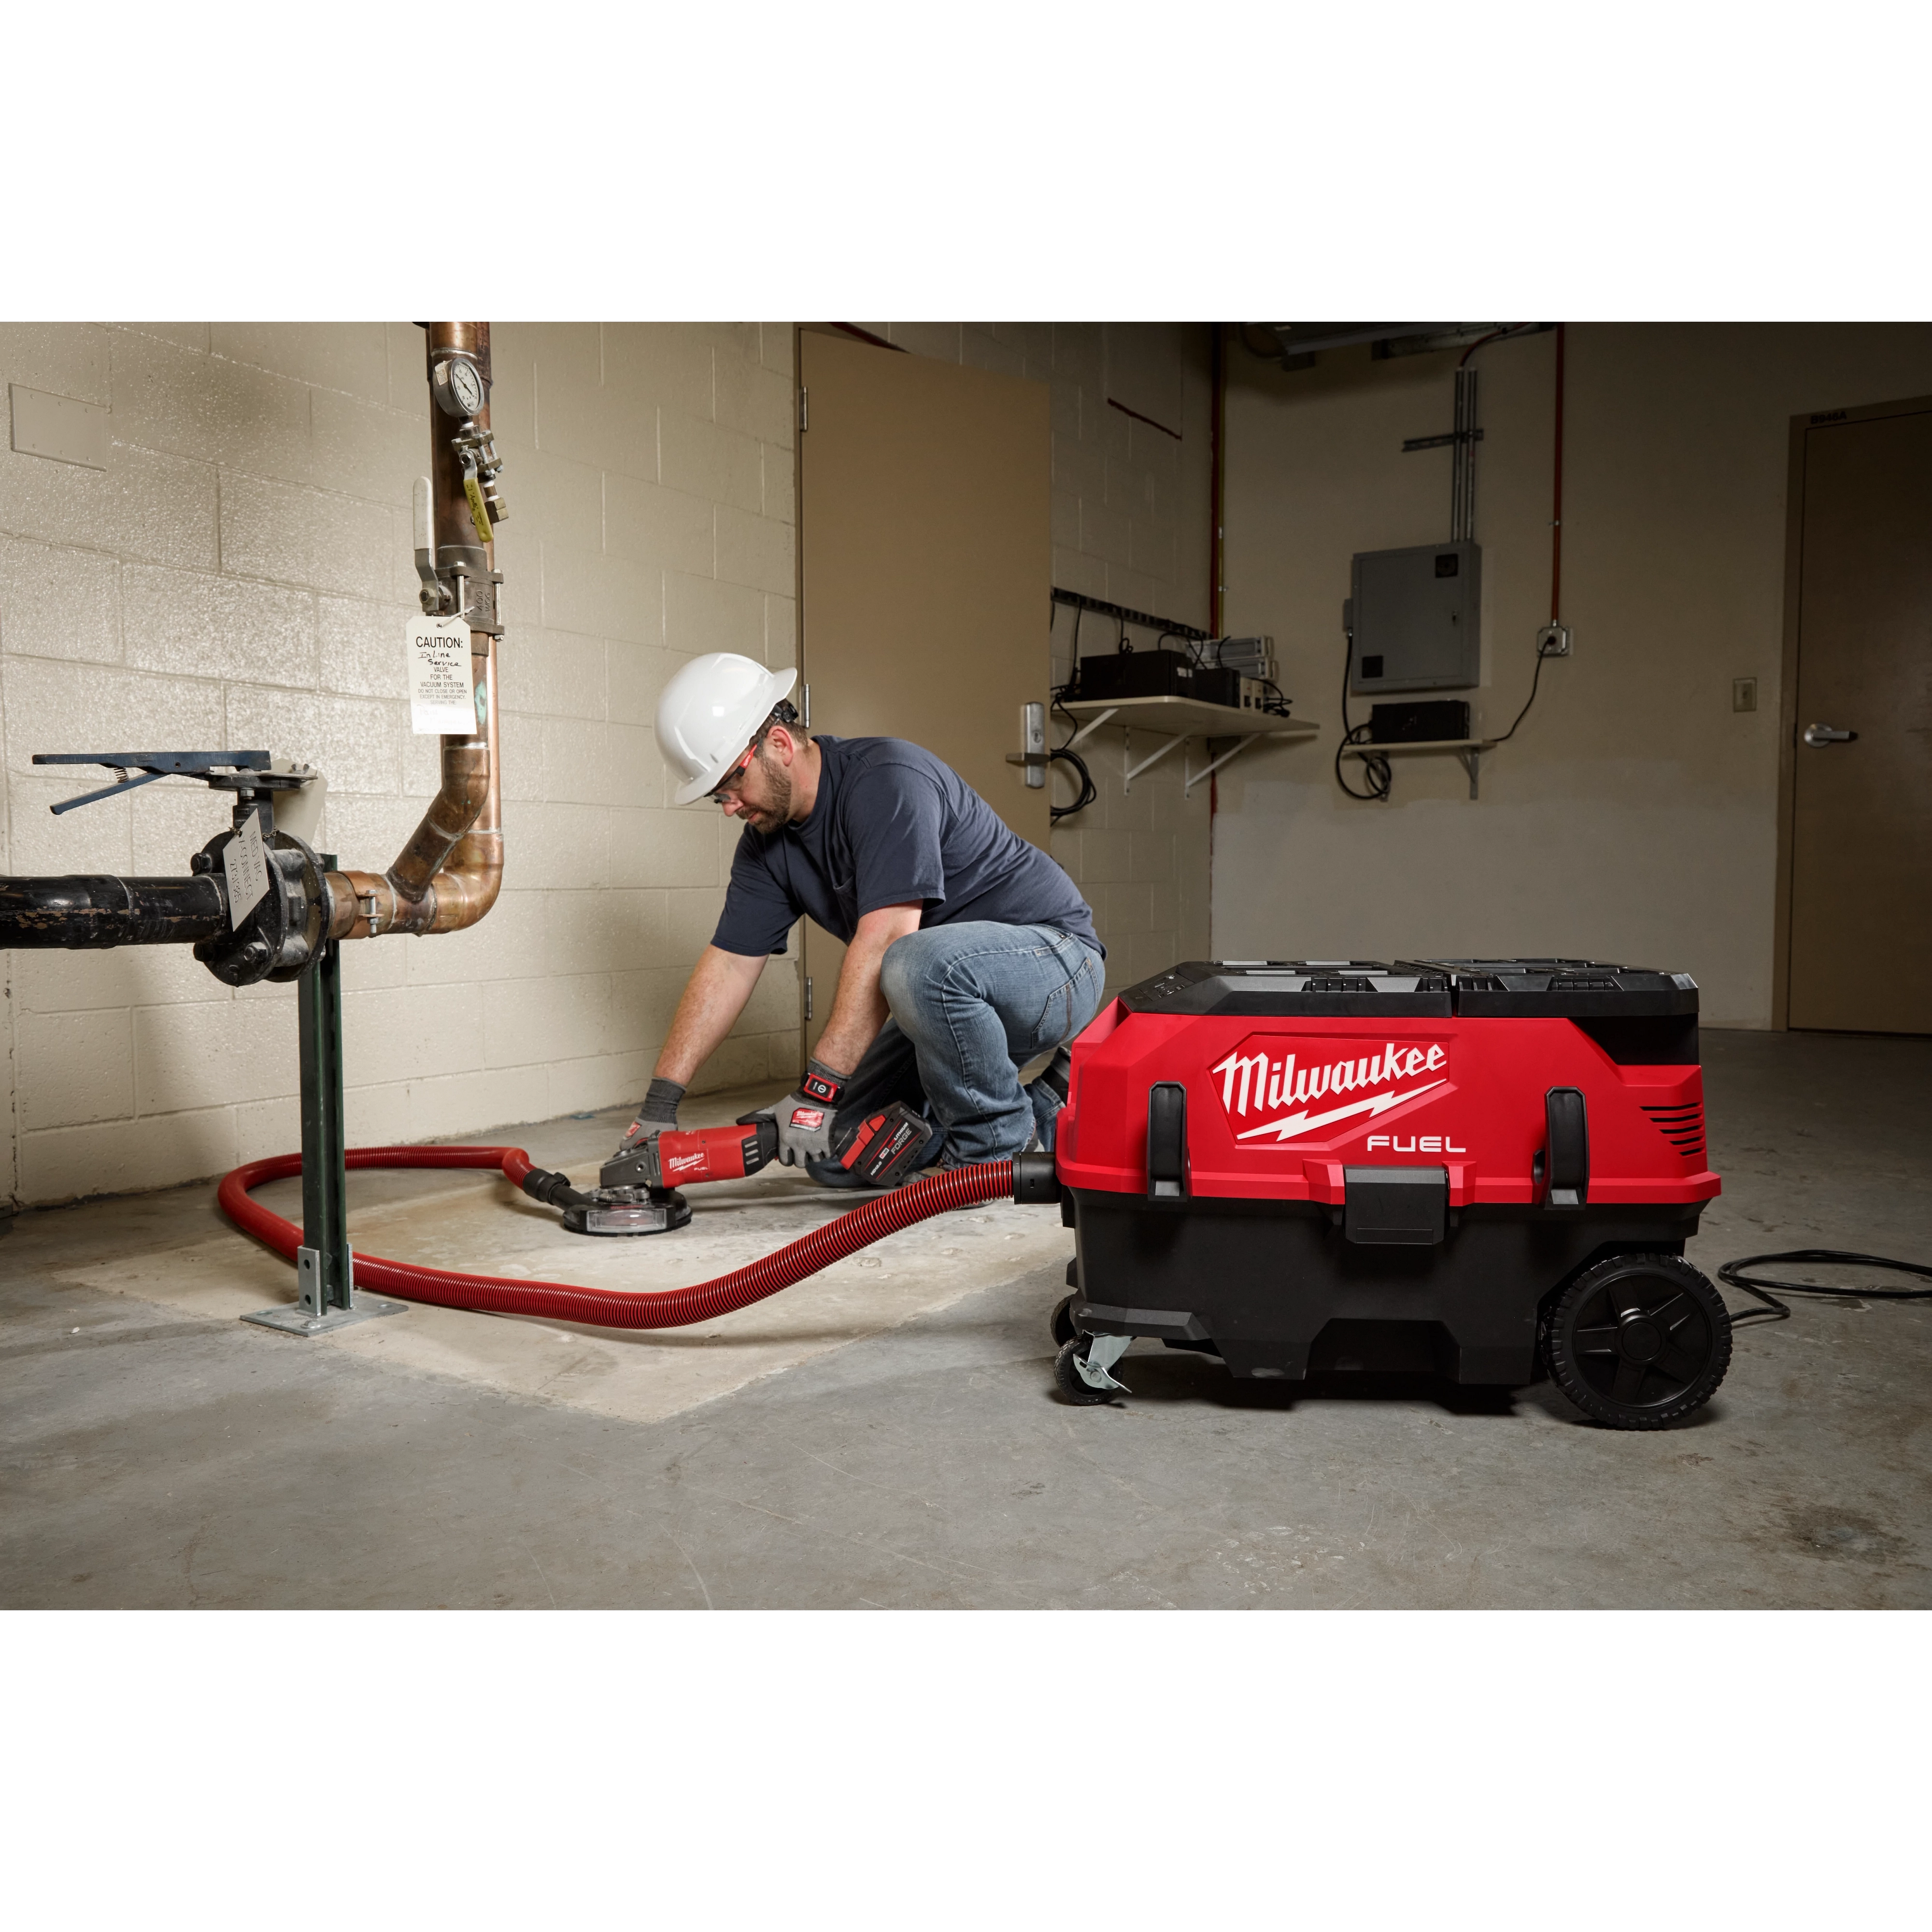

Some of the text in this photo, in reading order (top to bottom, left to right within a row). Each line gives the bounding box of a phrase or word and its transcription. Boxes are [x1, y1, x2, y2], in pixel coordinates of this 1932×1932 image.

[416, 636, 463, 648] CAUTION:
[249, 831, 262, 881] MED VAC
[238, 836, 253, 901] X-CONNECT
[1212, 1043, 1447, 1117] Milwaukee
[888, 1122, 909, 1149] REDLITHIUM
[891, 1128, 912, 1155] FORGE
[1367, 1135, 1466, 1152] FUEL
[668, 1152, 705, 1169] Milwaukee
[880, 1149, 889, 1158] M18
[870, 1161, 882, 1176] HD12.0
